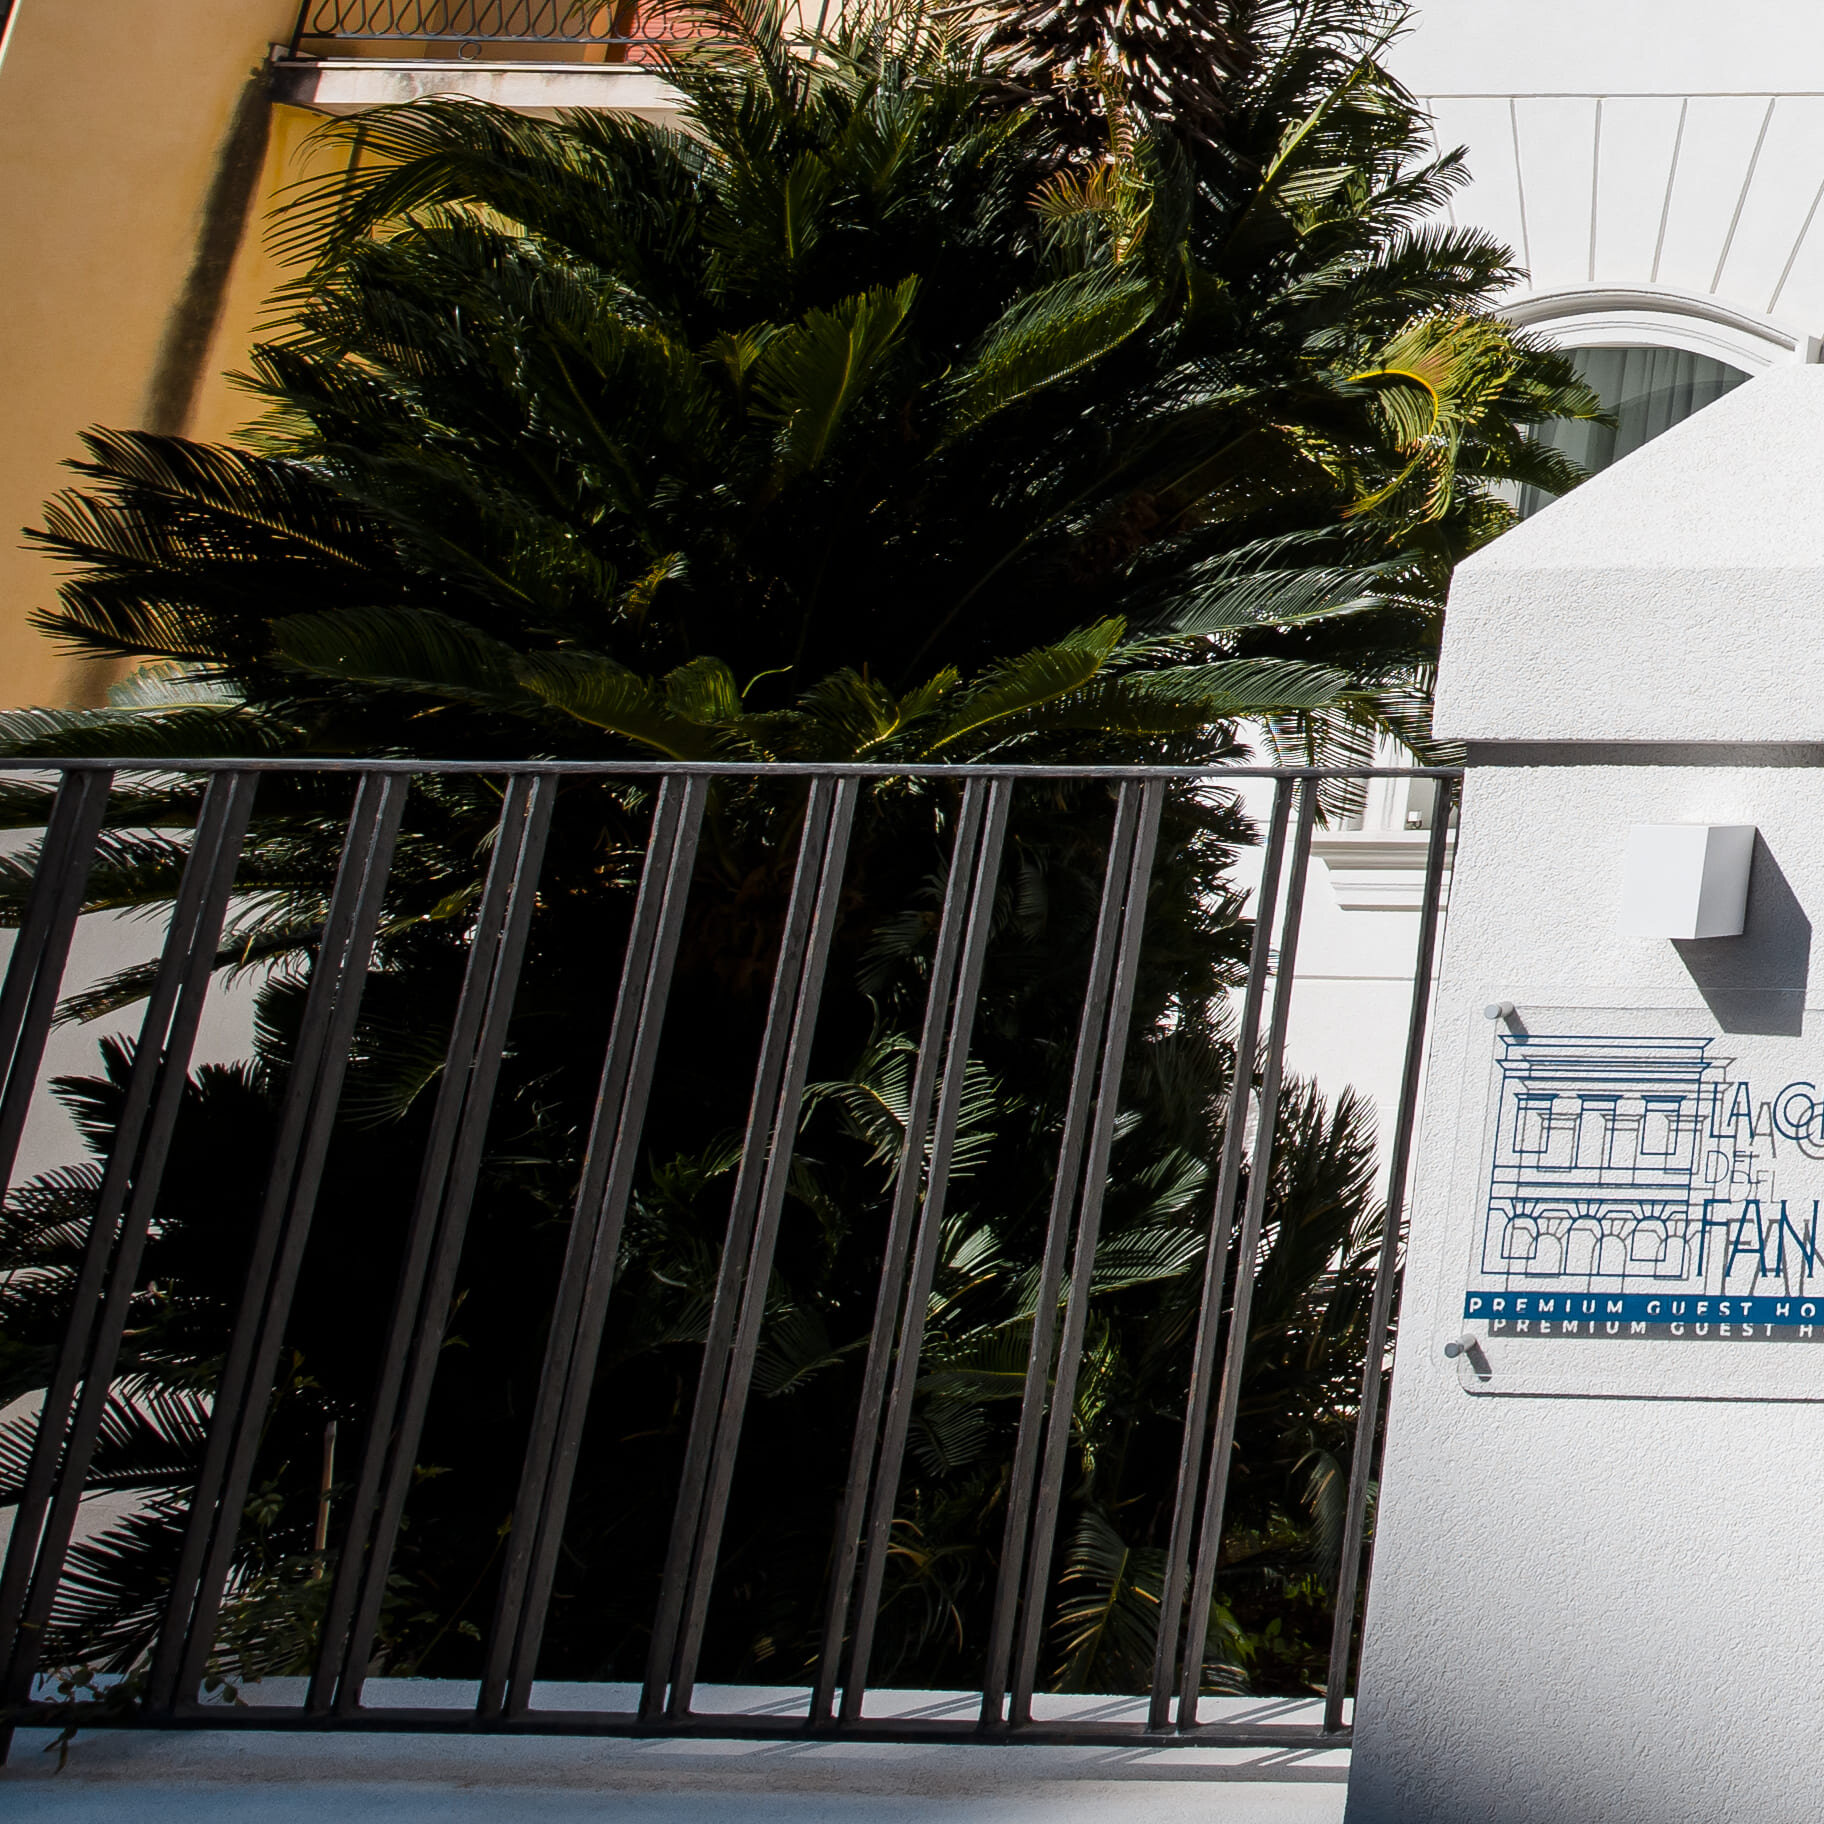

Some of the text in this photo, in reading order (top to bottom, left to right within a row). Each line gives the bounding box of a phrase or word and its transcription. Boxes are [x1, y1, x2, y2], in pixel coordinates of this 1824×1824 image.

[1709, 1081, 1755, 1140] LA
[1704, 1150, 1761, 1185] DEL
[1468, 1296, 1624, 1315] PREMIUM
[1647, 1299, 1753, 1317] GUEST
